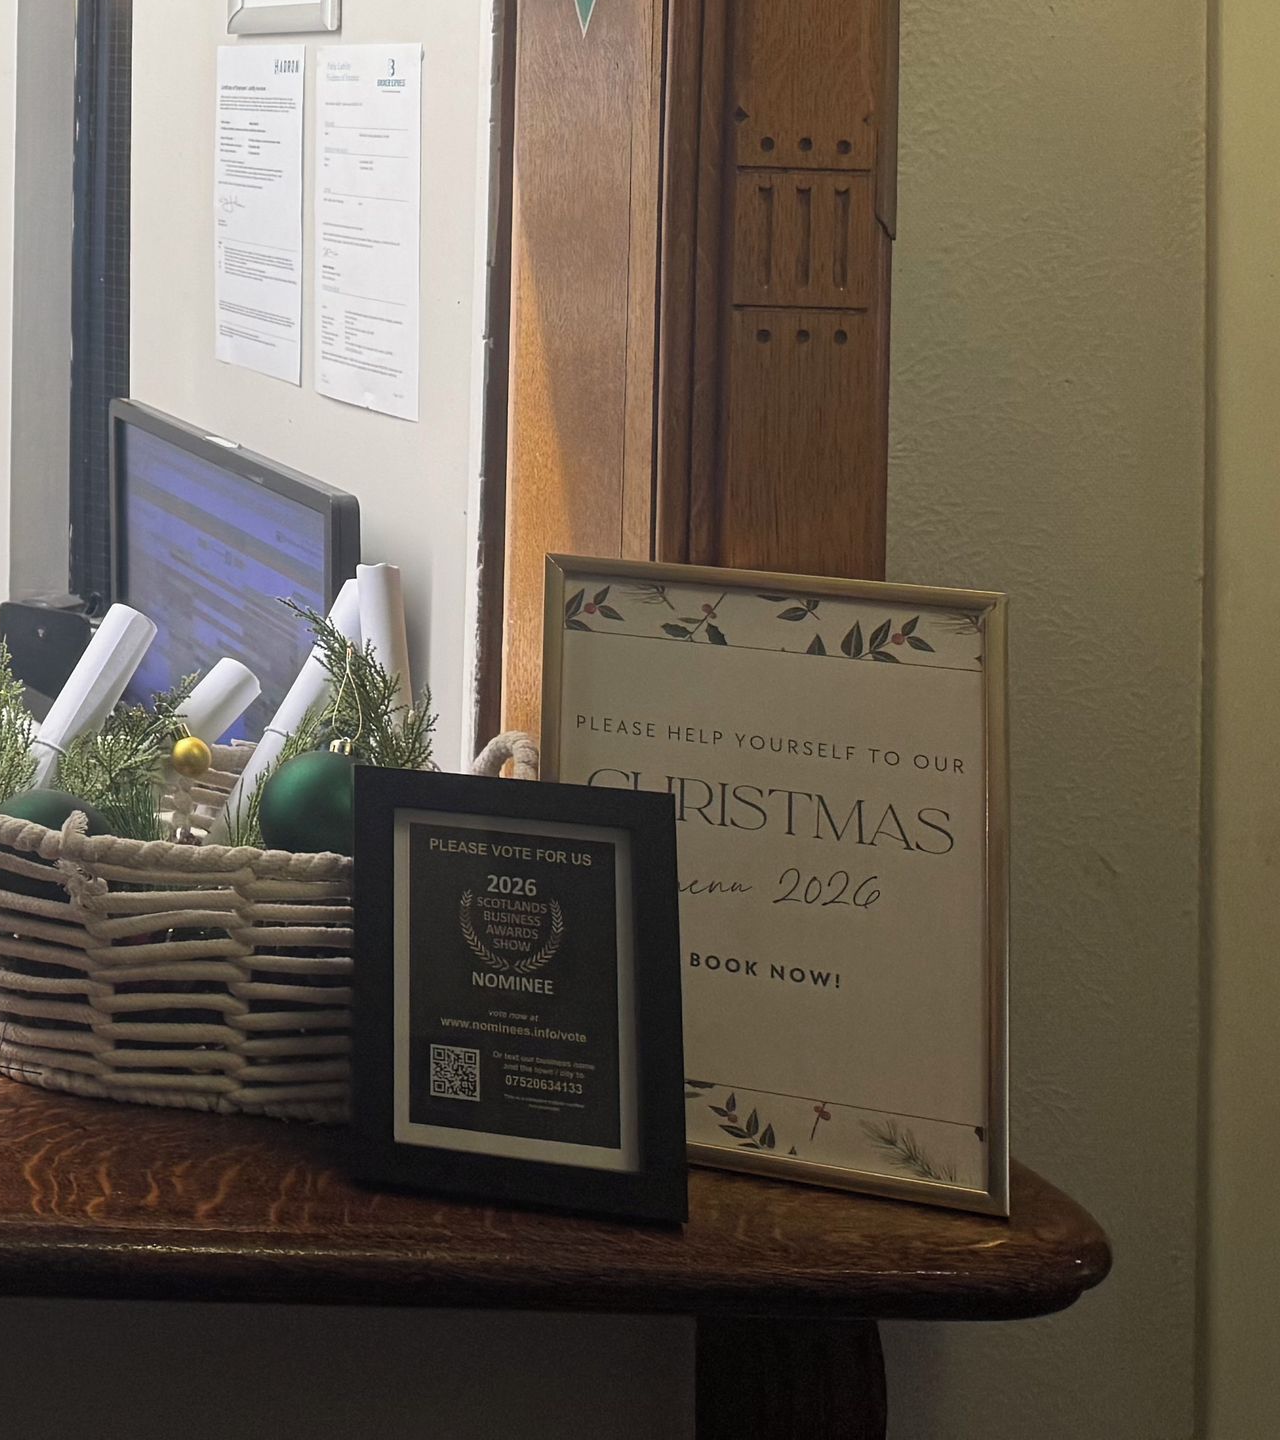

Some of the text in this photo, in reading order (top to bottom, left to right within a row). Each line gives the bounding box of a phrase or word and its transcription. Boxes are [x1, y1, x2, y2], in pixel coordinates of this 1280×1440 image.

[576, 713, 966, 775] PLEASE HELP YOURSELF TO OUR
[429, 838, 592, 866] PLEASE VOTE FOR US
[487, 875, 537, 897] 2026
[677, 867, 881, 909] enu 2026
[476, 896, 548, 914] SCOTLANDS
[483, 910, 541, 926] BUSINESS
[486, 924, 539, 940] AWARDS
[493, 938, 532, 952] SHOW
[689, 952, 842, 989] BOOK NOW!
[472, 971, 555, 995] NOMINEE
[488, 1010, 508, 1019] vote
[508, 1012, 528, 1020] now
[440, 1017, 587, 1043] www.nominees.info/vote
[505, 1075, 583, 1095] 07520634133
